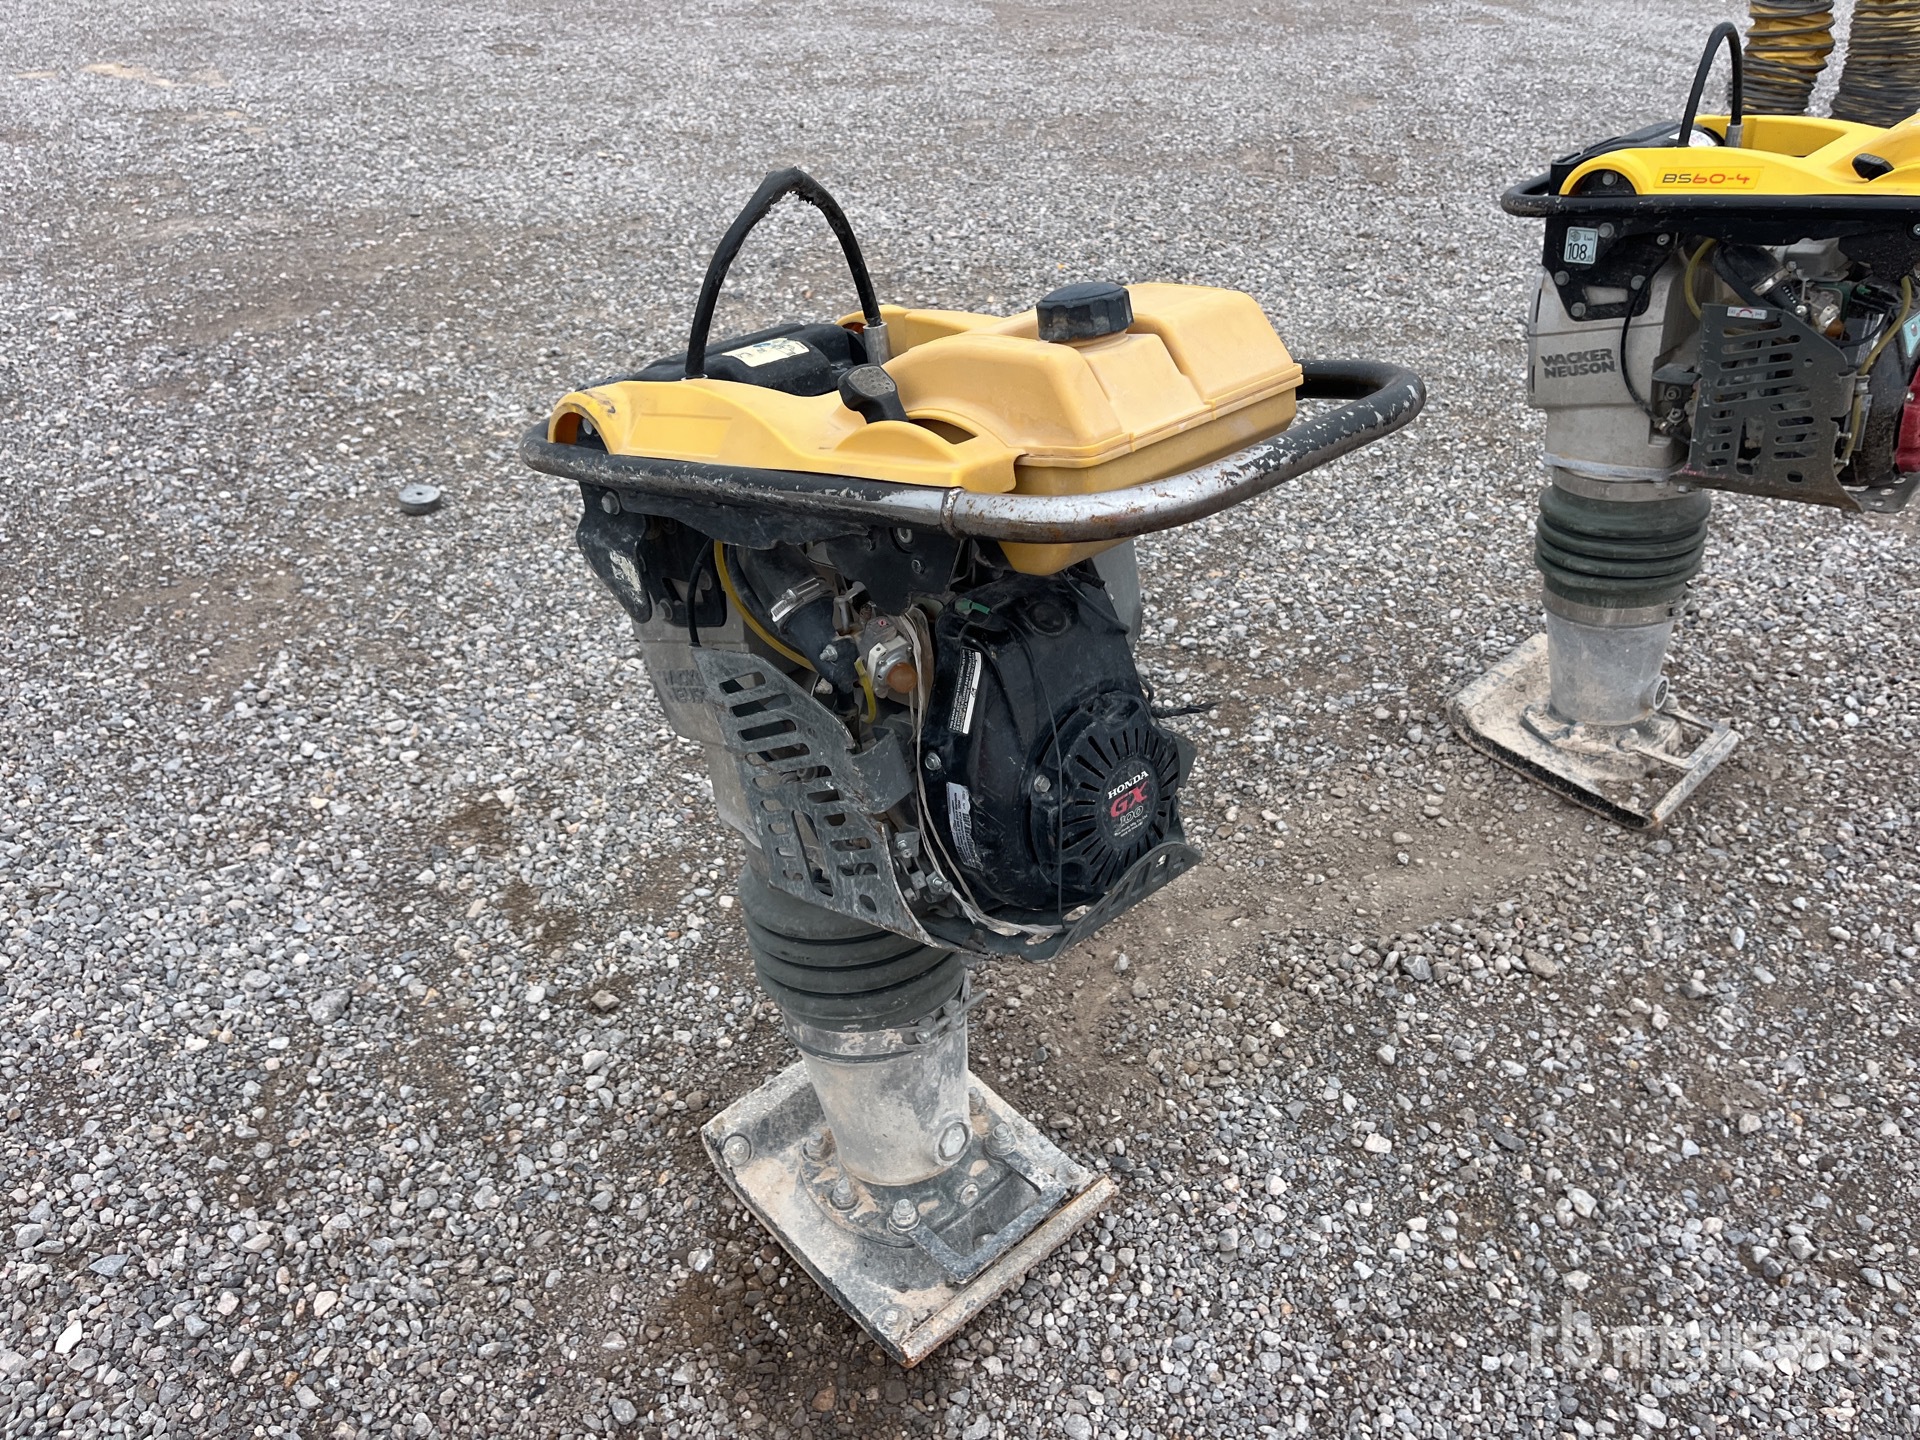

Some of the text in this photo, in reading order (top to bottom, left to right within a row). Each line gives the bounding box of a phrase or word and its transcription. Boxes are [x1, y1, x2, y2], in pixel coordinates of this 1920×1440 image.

[1662, 172, 1750, 185] BS60-4
[1567, 242, 1588, 261] 108
[1540, 347, 1614, 367] WACKER
[1543, 360, 1616, 379] NEUSON
[1107, 770, 1149, 799] HONDA
[1110, 780, 1149, 817] GX
